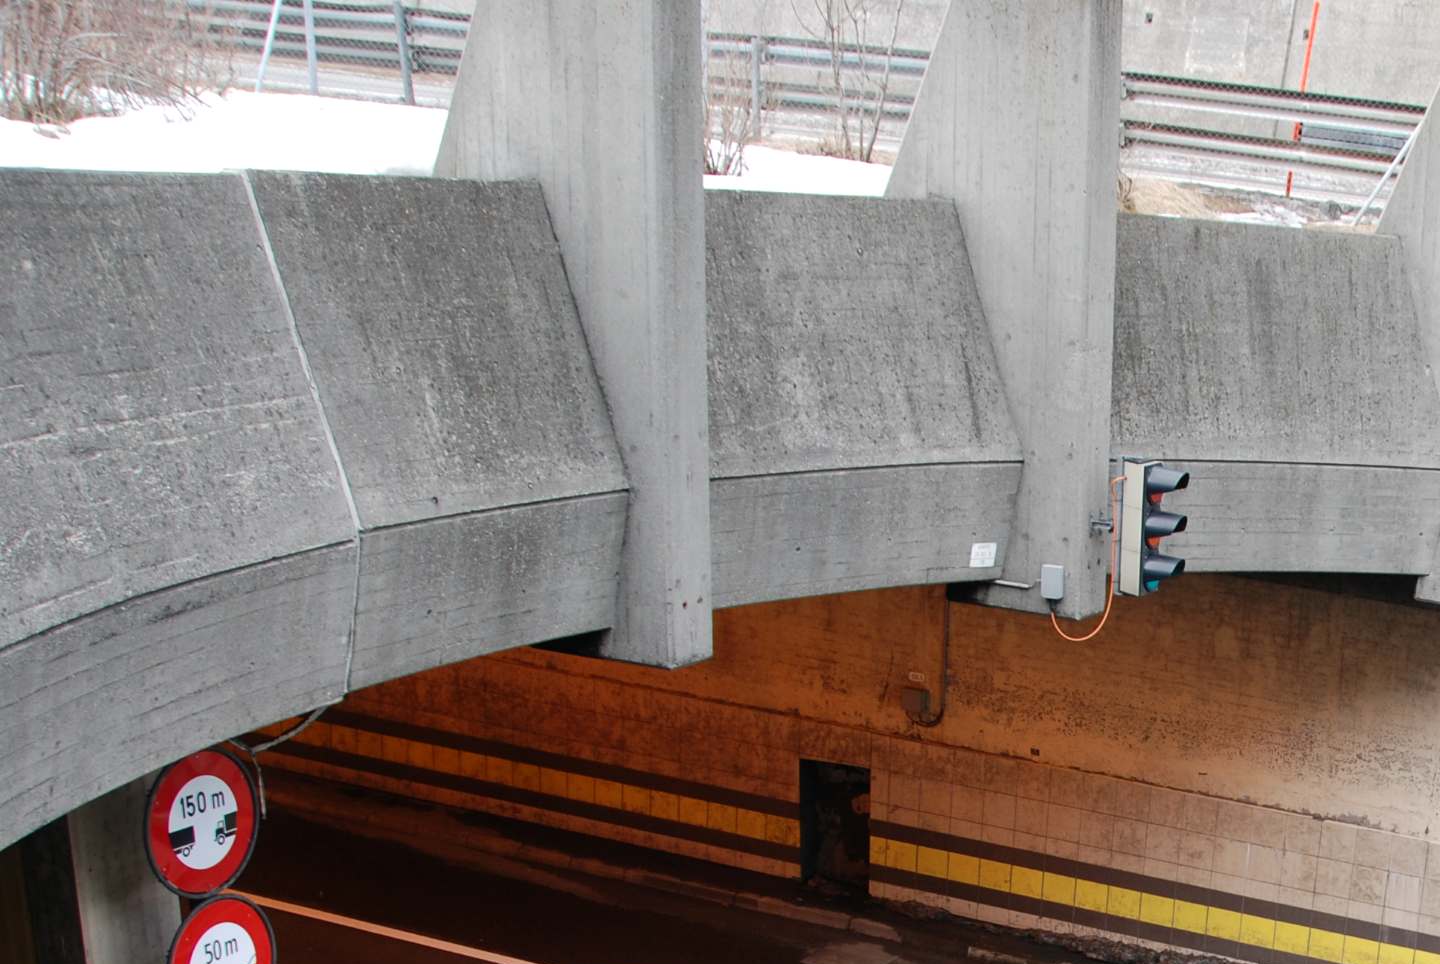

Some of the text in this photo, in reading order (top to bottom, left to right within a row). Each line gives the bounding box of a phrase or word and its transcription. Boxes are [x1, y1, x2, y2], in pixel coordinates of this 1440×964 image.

[180, 790, 225, 819] 150 m
[204, 936, 239, 964] 50 m
